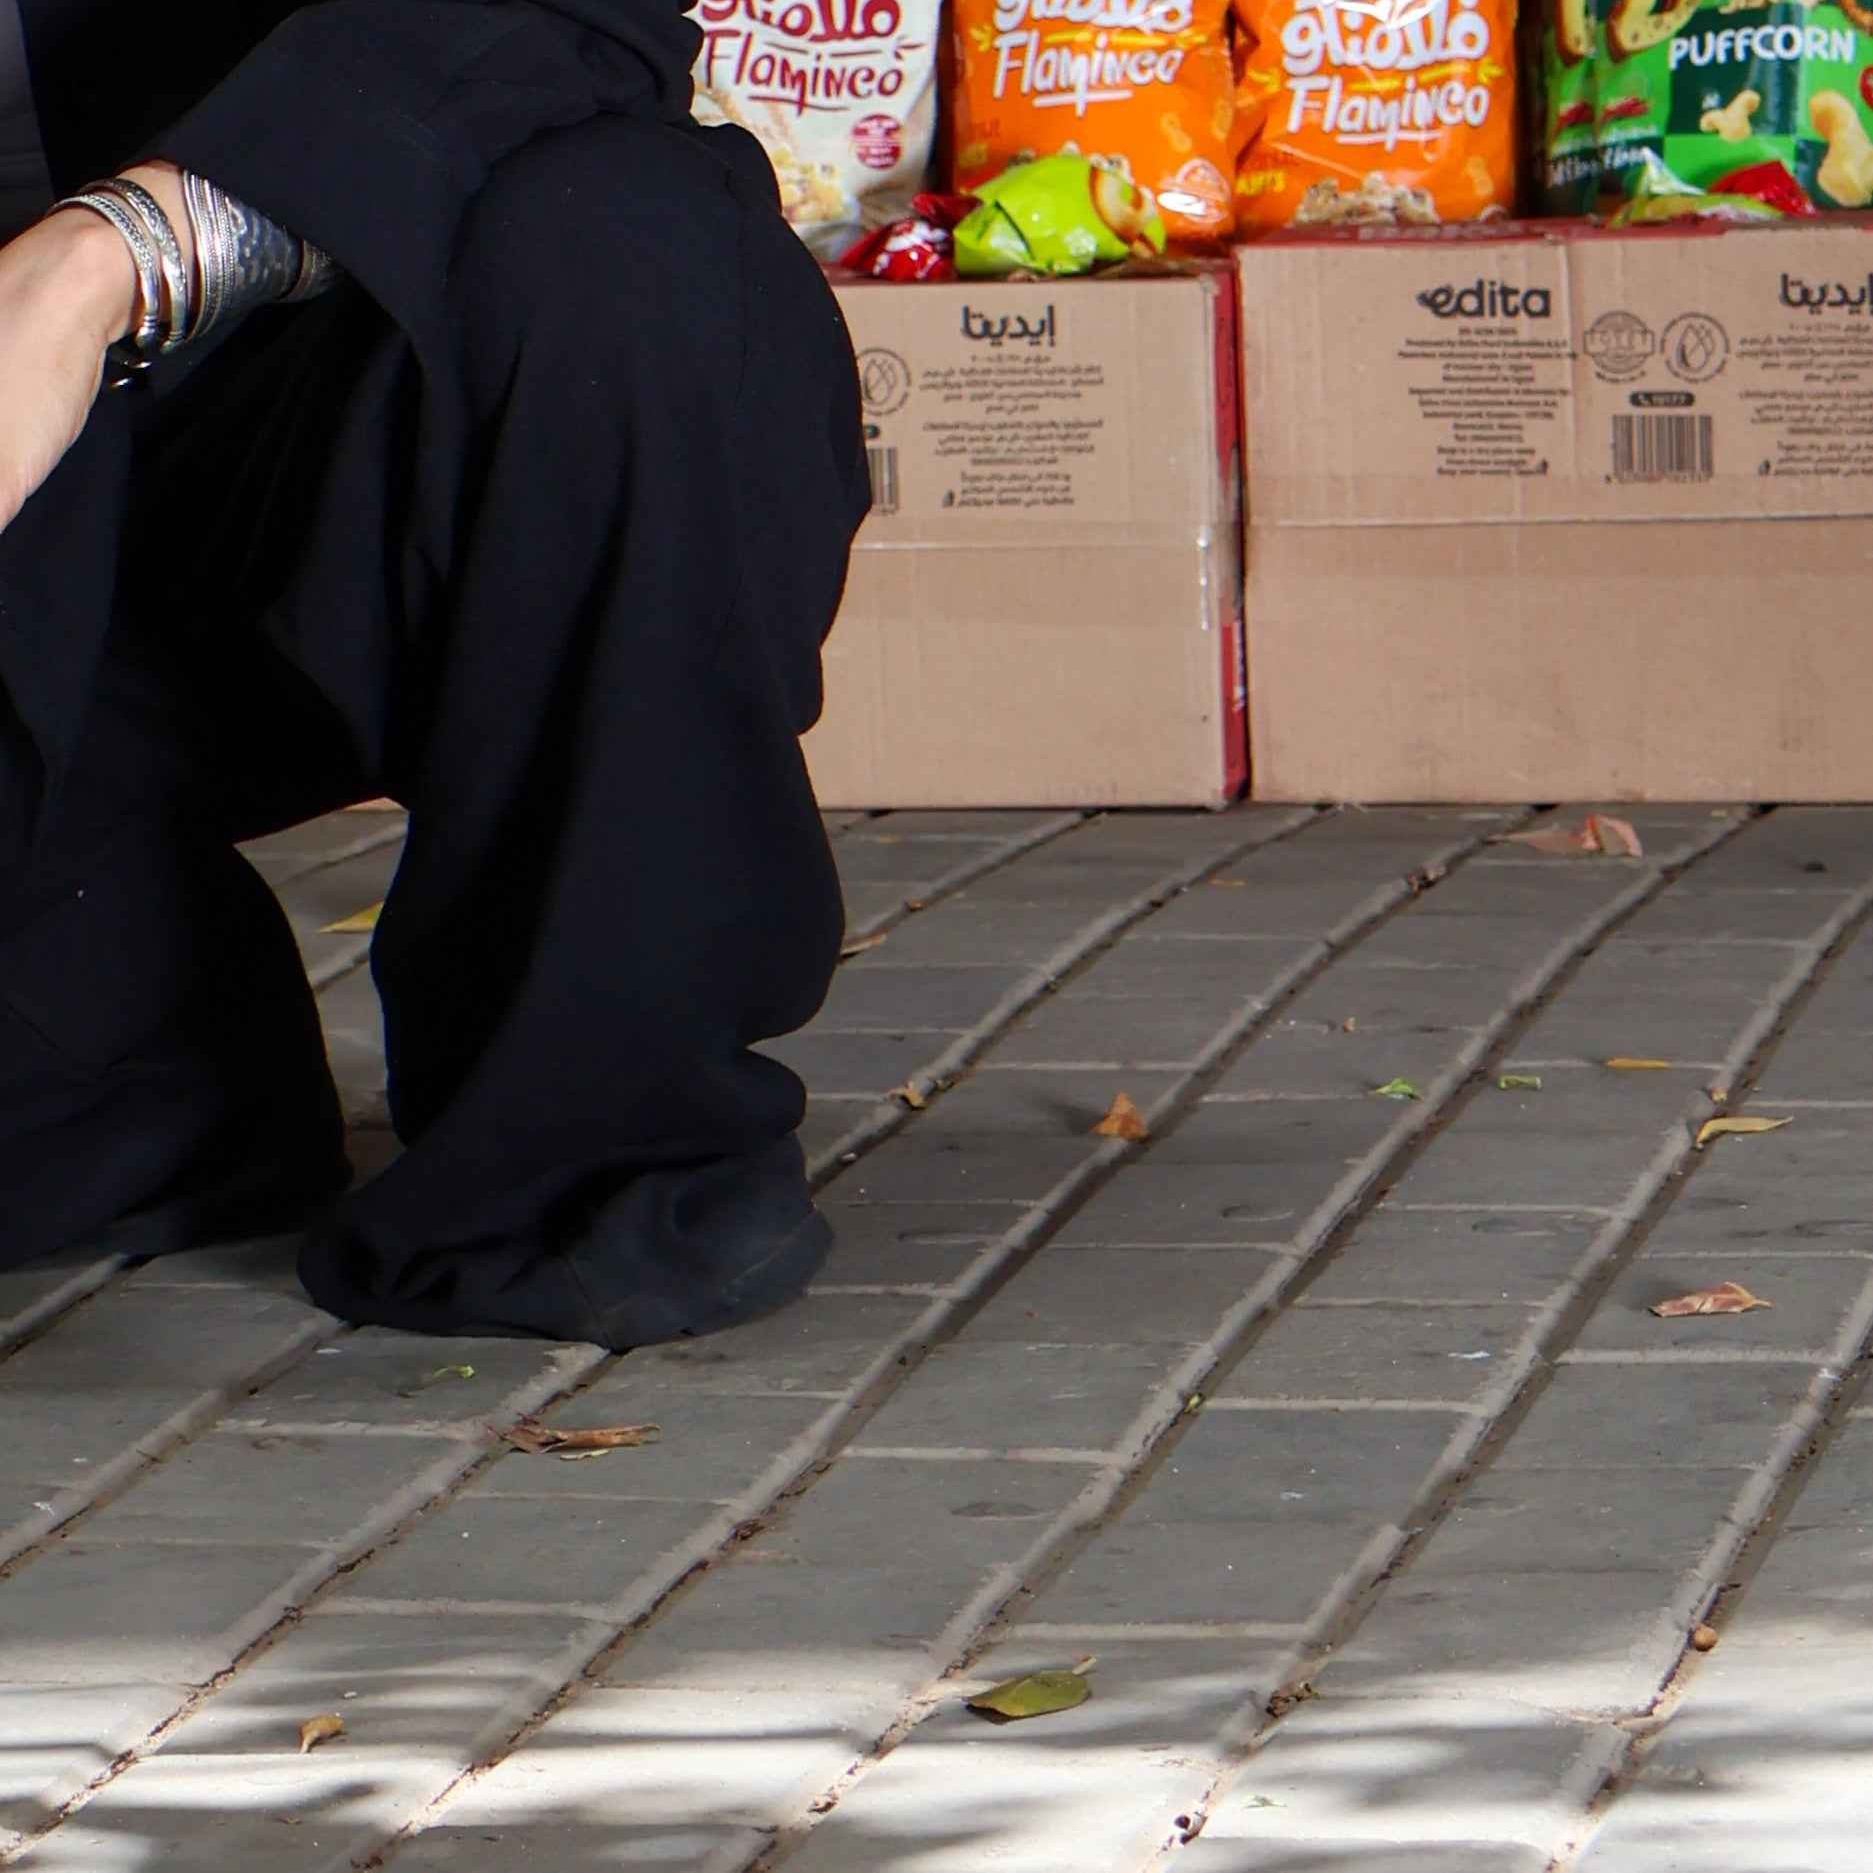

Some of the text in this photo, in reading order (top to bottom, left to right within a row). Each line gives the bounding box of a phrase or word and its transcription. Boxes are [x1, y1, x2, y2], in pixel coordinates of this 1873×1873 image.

[1668, 25, 1856, 70] PUFFCORN
[1415, 279, 1551, 317] edita
[961, 304, 1056, 347] إيديتا
